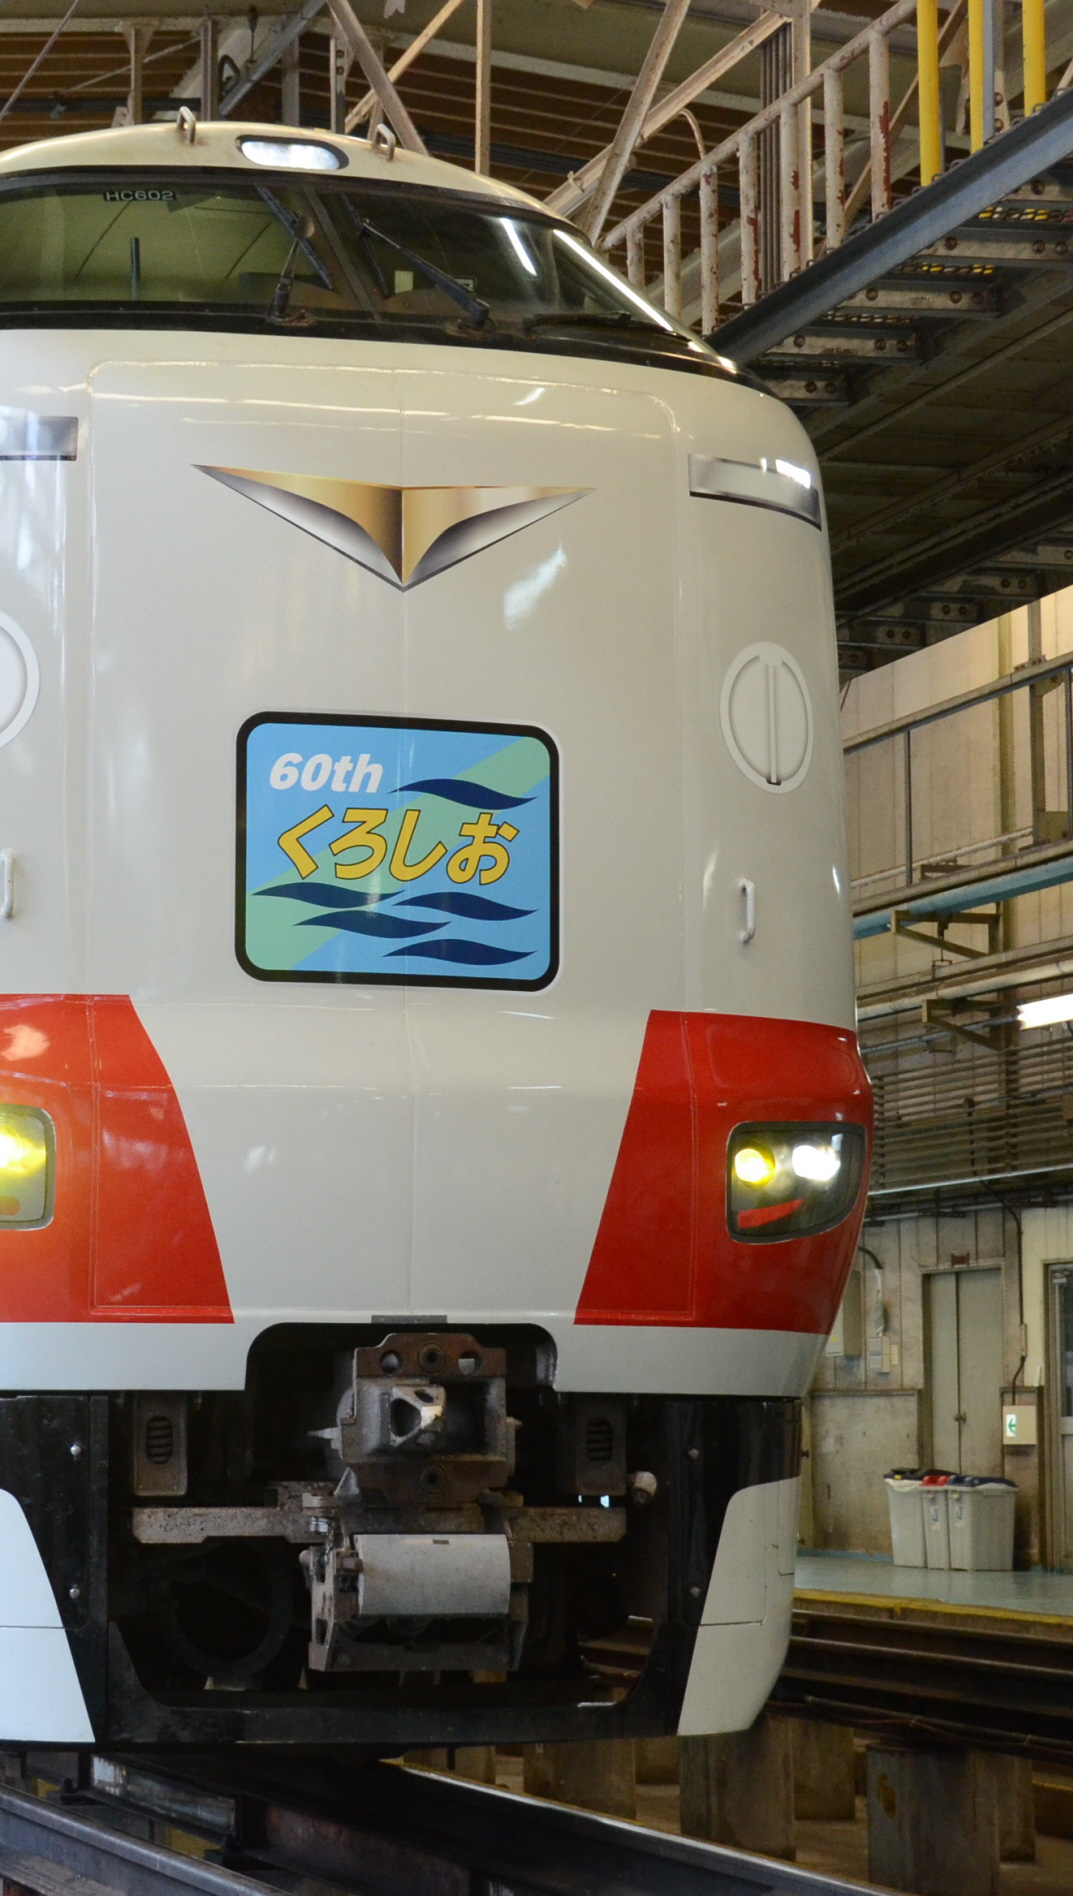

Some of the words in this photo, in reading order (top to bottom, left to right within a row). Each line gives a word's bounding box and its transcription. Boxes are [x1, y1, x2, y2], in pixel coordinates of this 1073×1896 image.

[106, 190, 174, 201] HC602
[269, 752, 384, 794] 60th
[278, 804, 520, 885] くろしお
